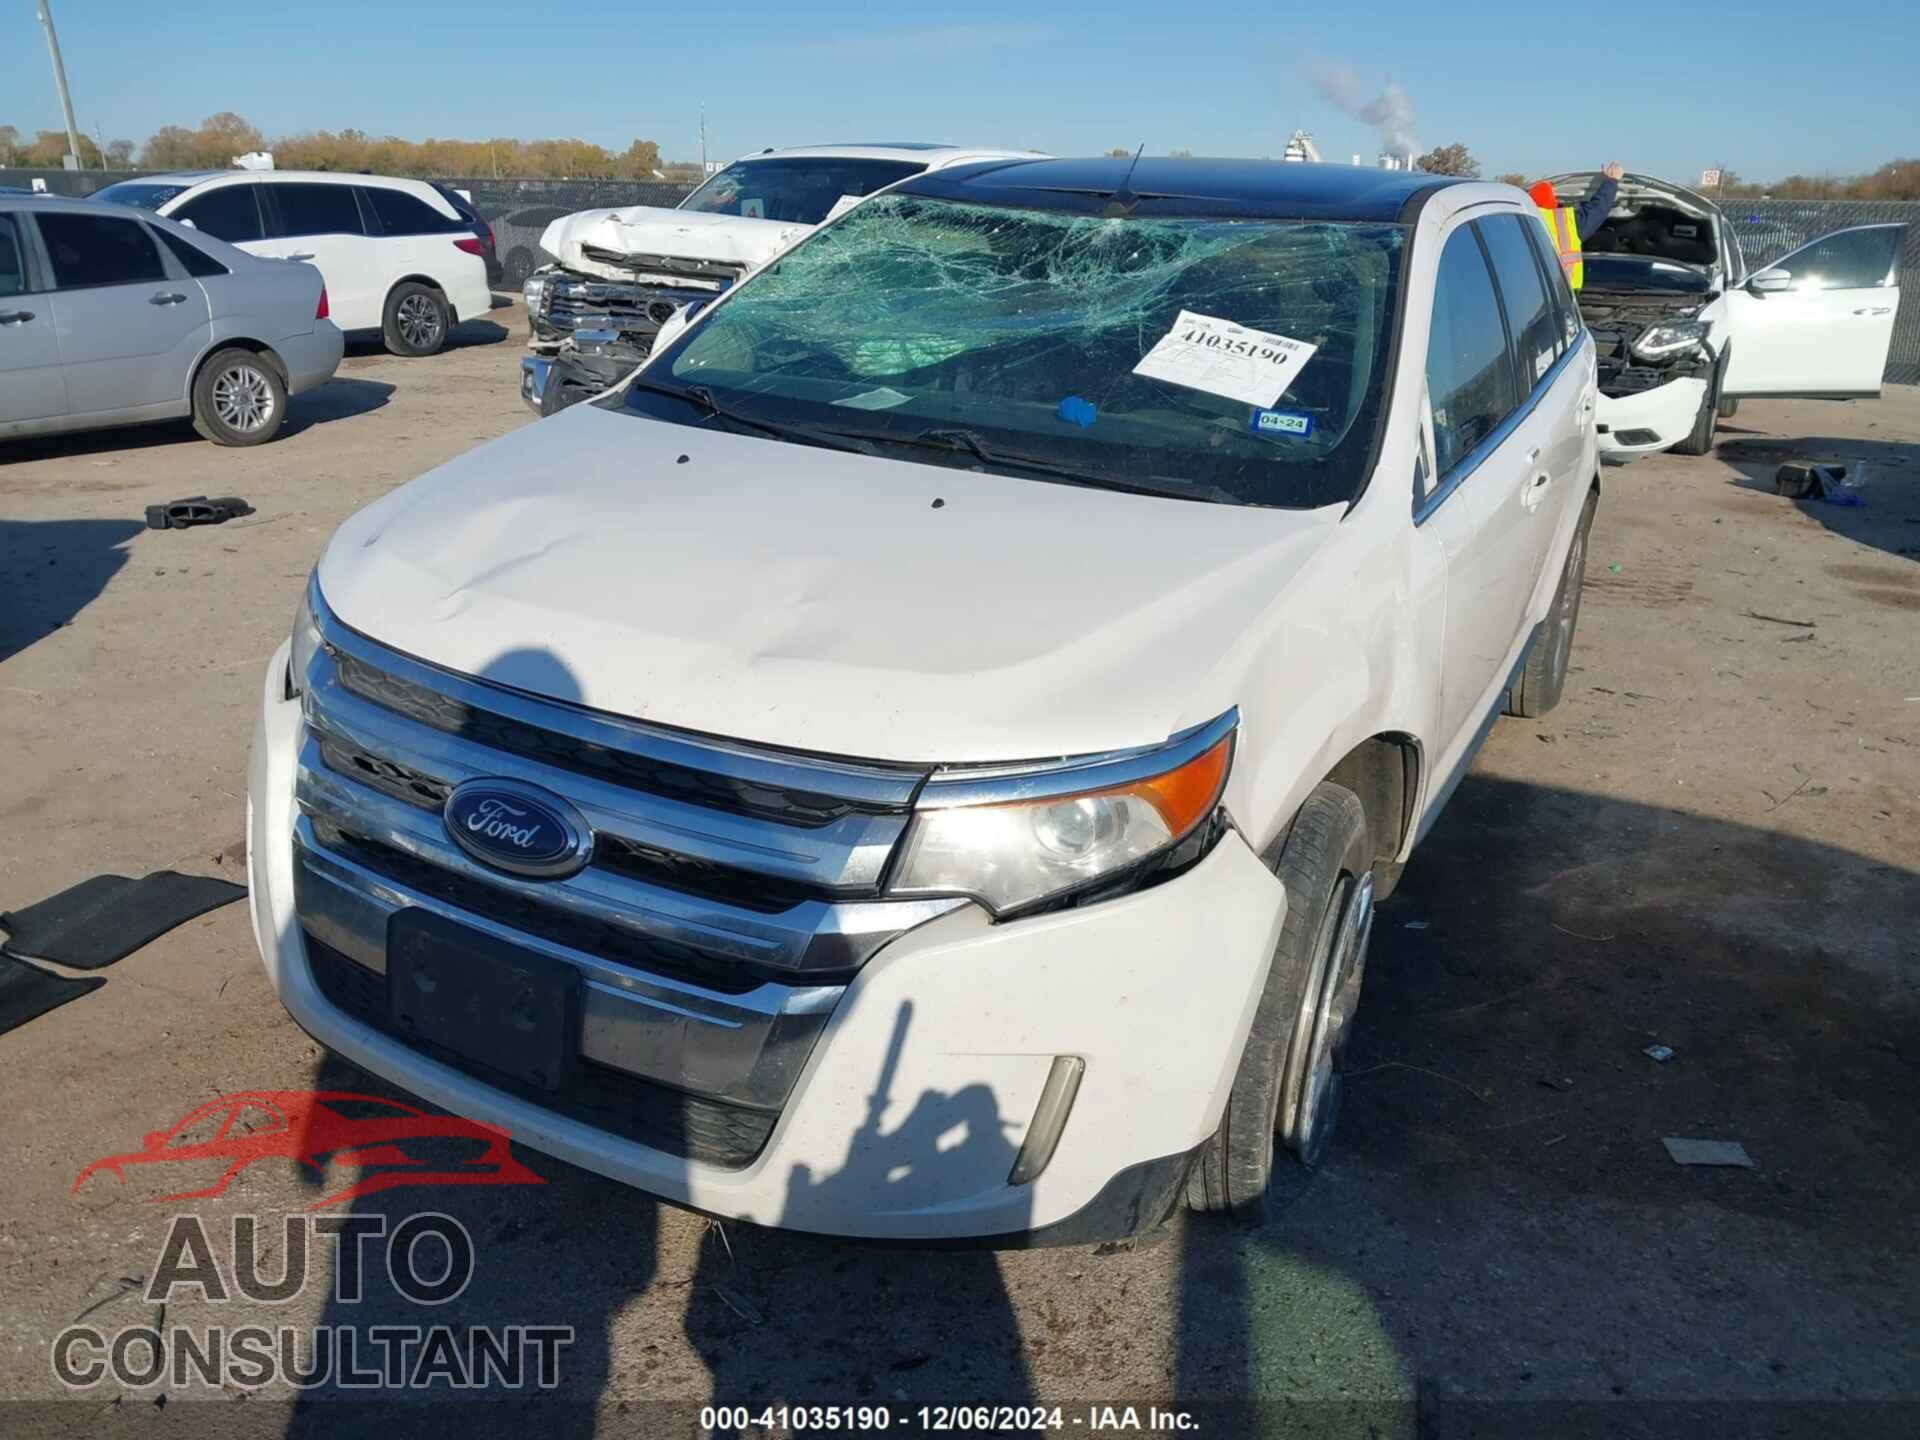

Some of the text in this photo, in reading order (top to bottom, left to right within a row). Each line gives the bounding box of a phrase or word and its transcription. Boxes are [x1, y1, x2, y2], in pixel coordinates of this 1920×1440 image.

[1182, 329, 1288, 364] 41035190
[1261, 415, 1304, 428] 04-24
[468, 799, 540, 847] Ford
